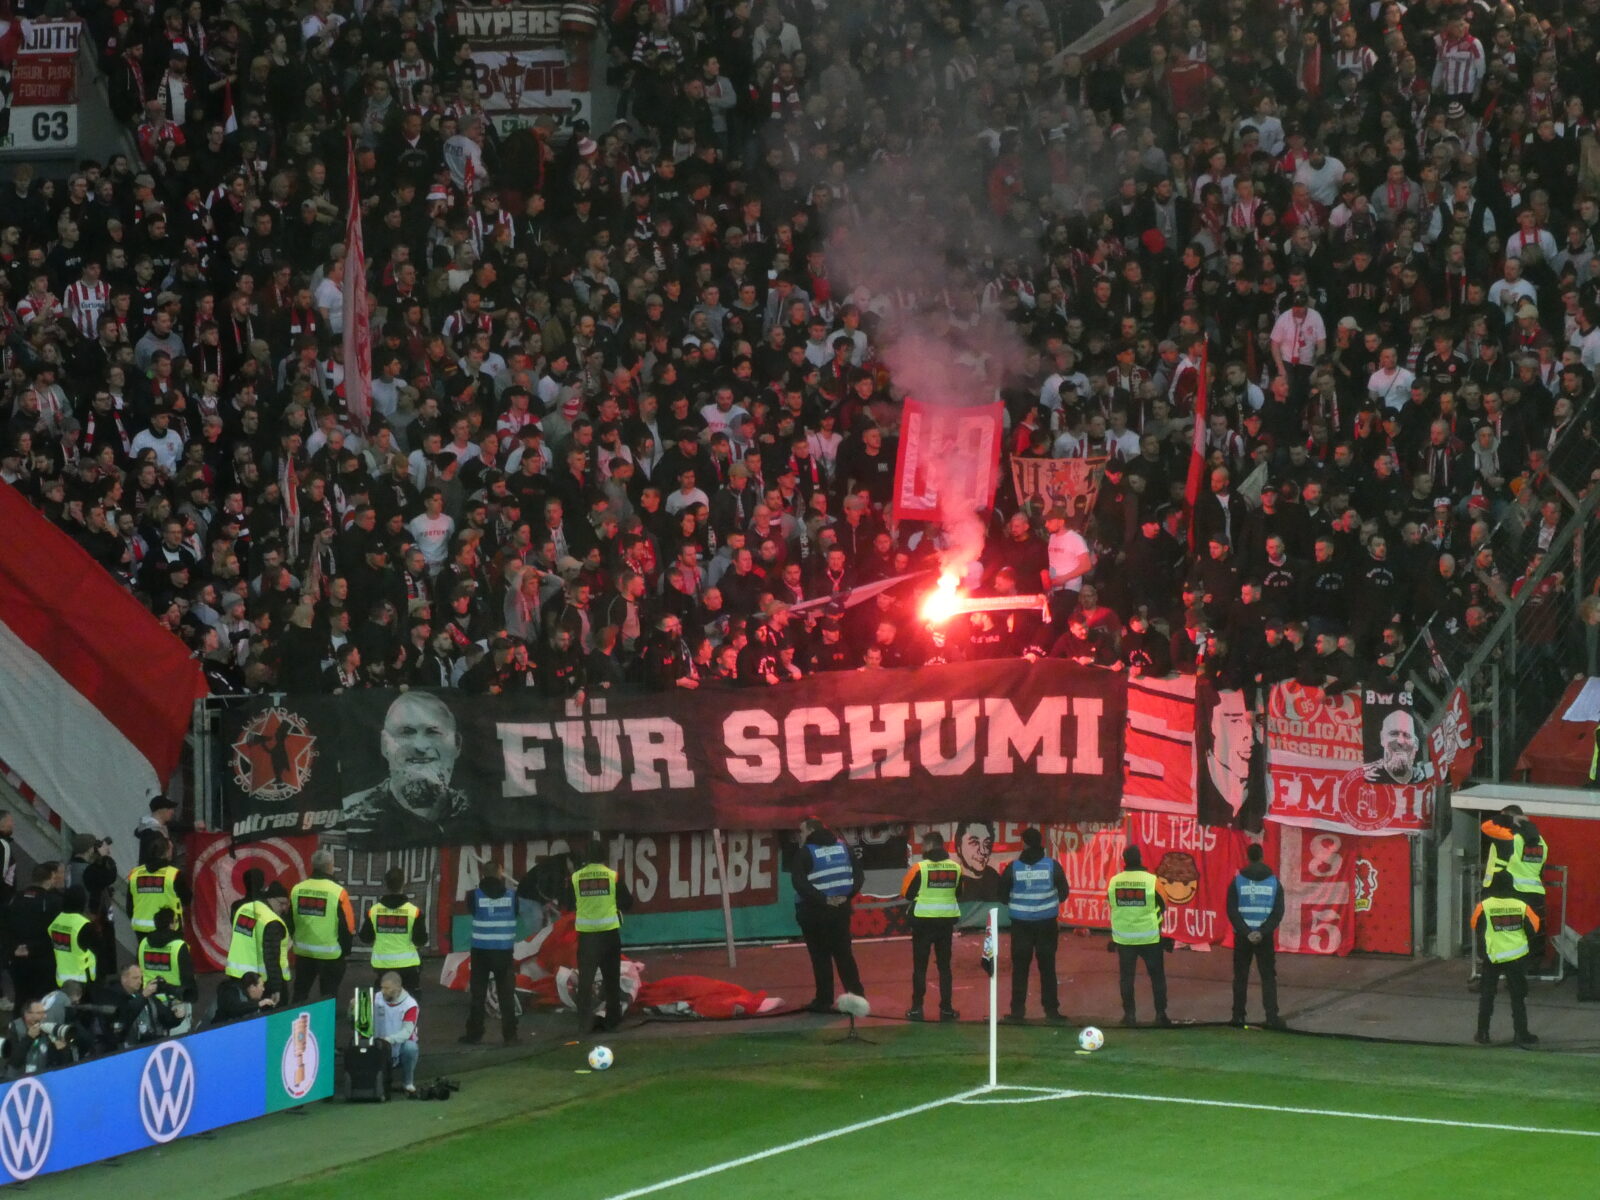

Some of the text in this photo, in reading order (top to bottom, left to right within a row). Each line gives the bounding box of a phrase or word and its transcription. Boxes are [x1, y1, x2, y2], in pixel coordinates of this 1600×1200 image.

[21, 27, 79, 51] OUTH
[457, 11, 560, 35] HYPERS
[32, 111, 69, 142] G3
[496, 695, 1103, 798] FÜR SCHUMI
[233, 809, 345, 837] ultras geg
[1141, 811, 1216, 851] ULTRAS
[669, 831, 772, 899] LIEBE
[1309, 834, 1343, 877] 8
[1185, 908, 1216, 939] GUT
[1309, 909, 1342, 953] 5
